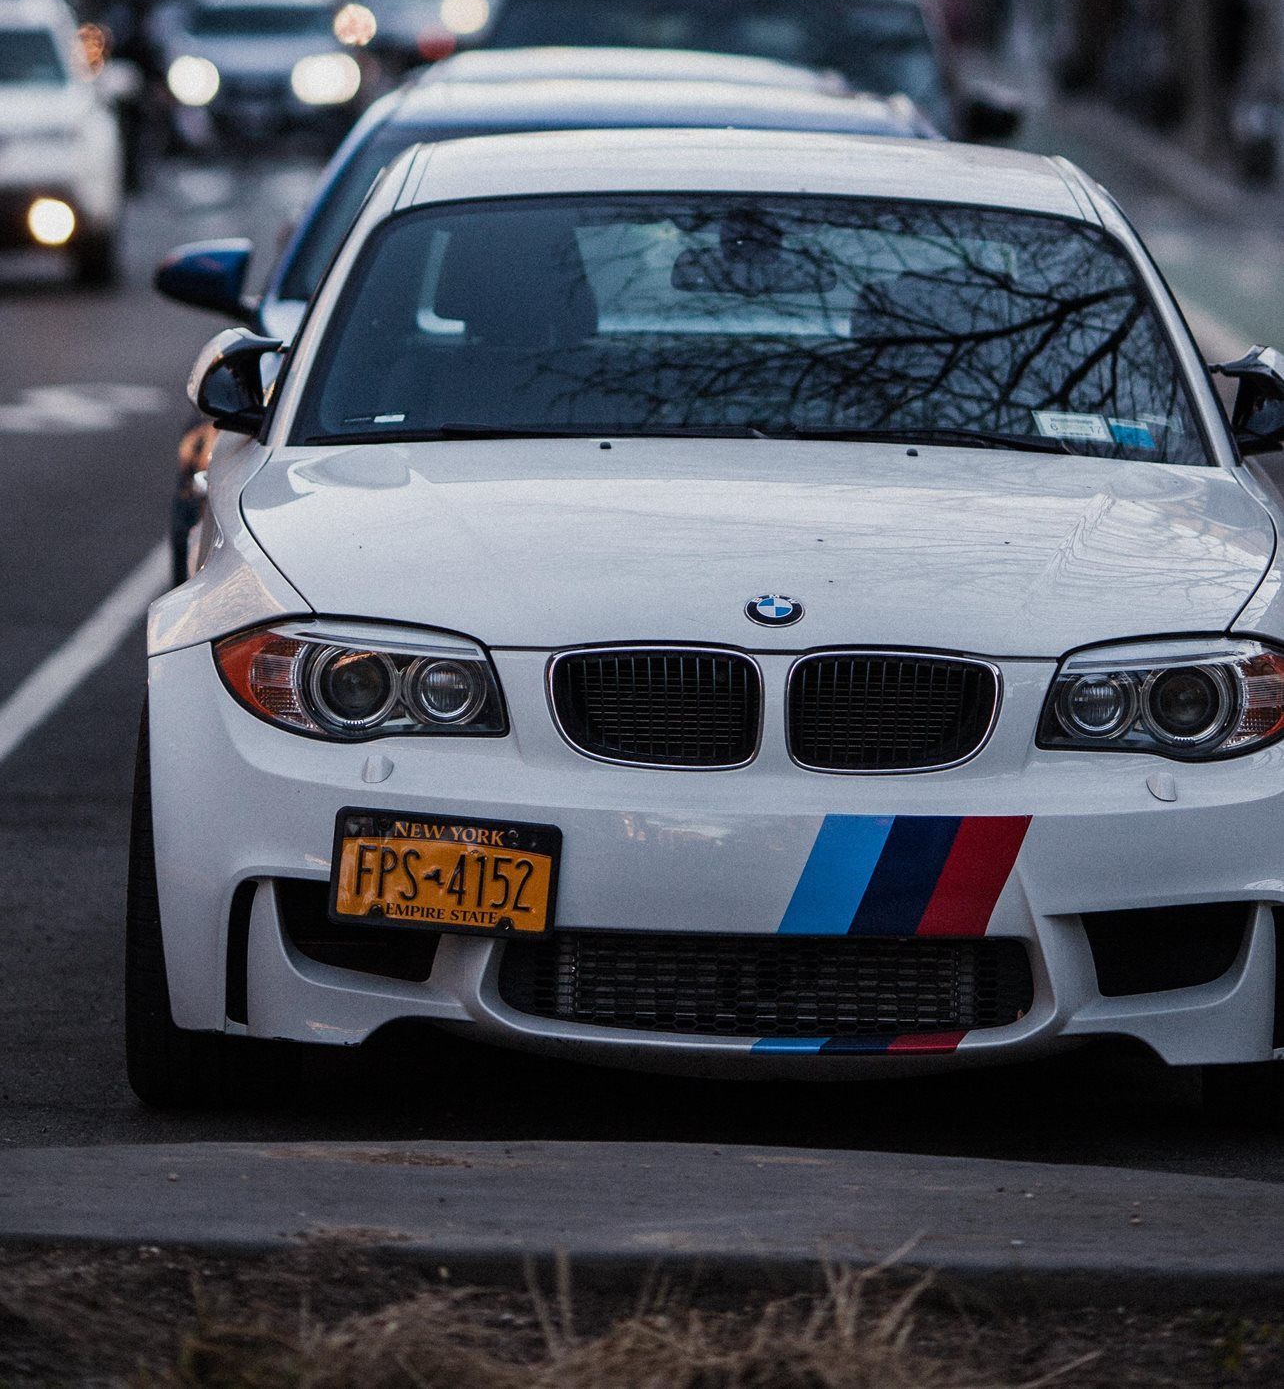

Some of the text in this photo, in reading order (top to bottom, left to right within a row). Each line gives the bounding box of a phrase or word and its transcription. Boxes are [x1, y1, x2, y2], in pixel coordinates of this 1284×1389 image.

[394, 821, 505, 846] NEW YORK
[385, 902, 498, 925] EMPIRE STATE
